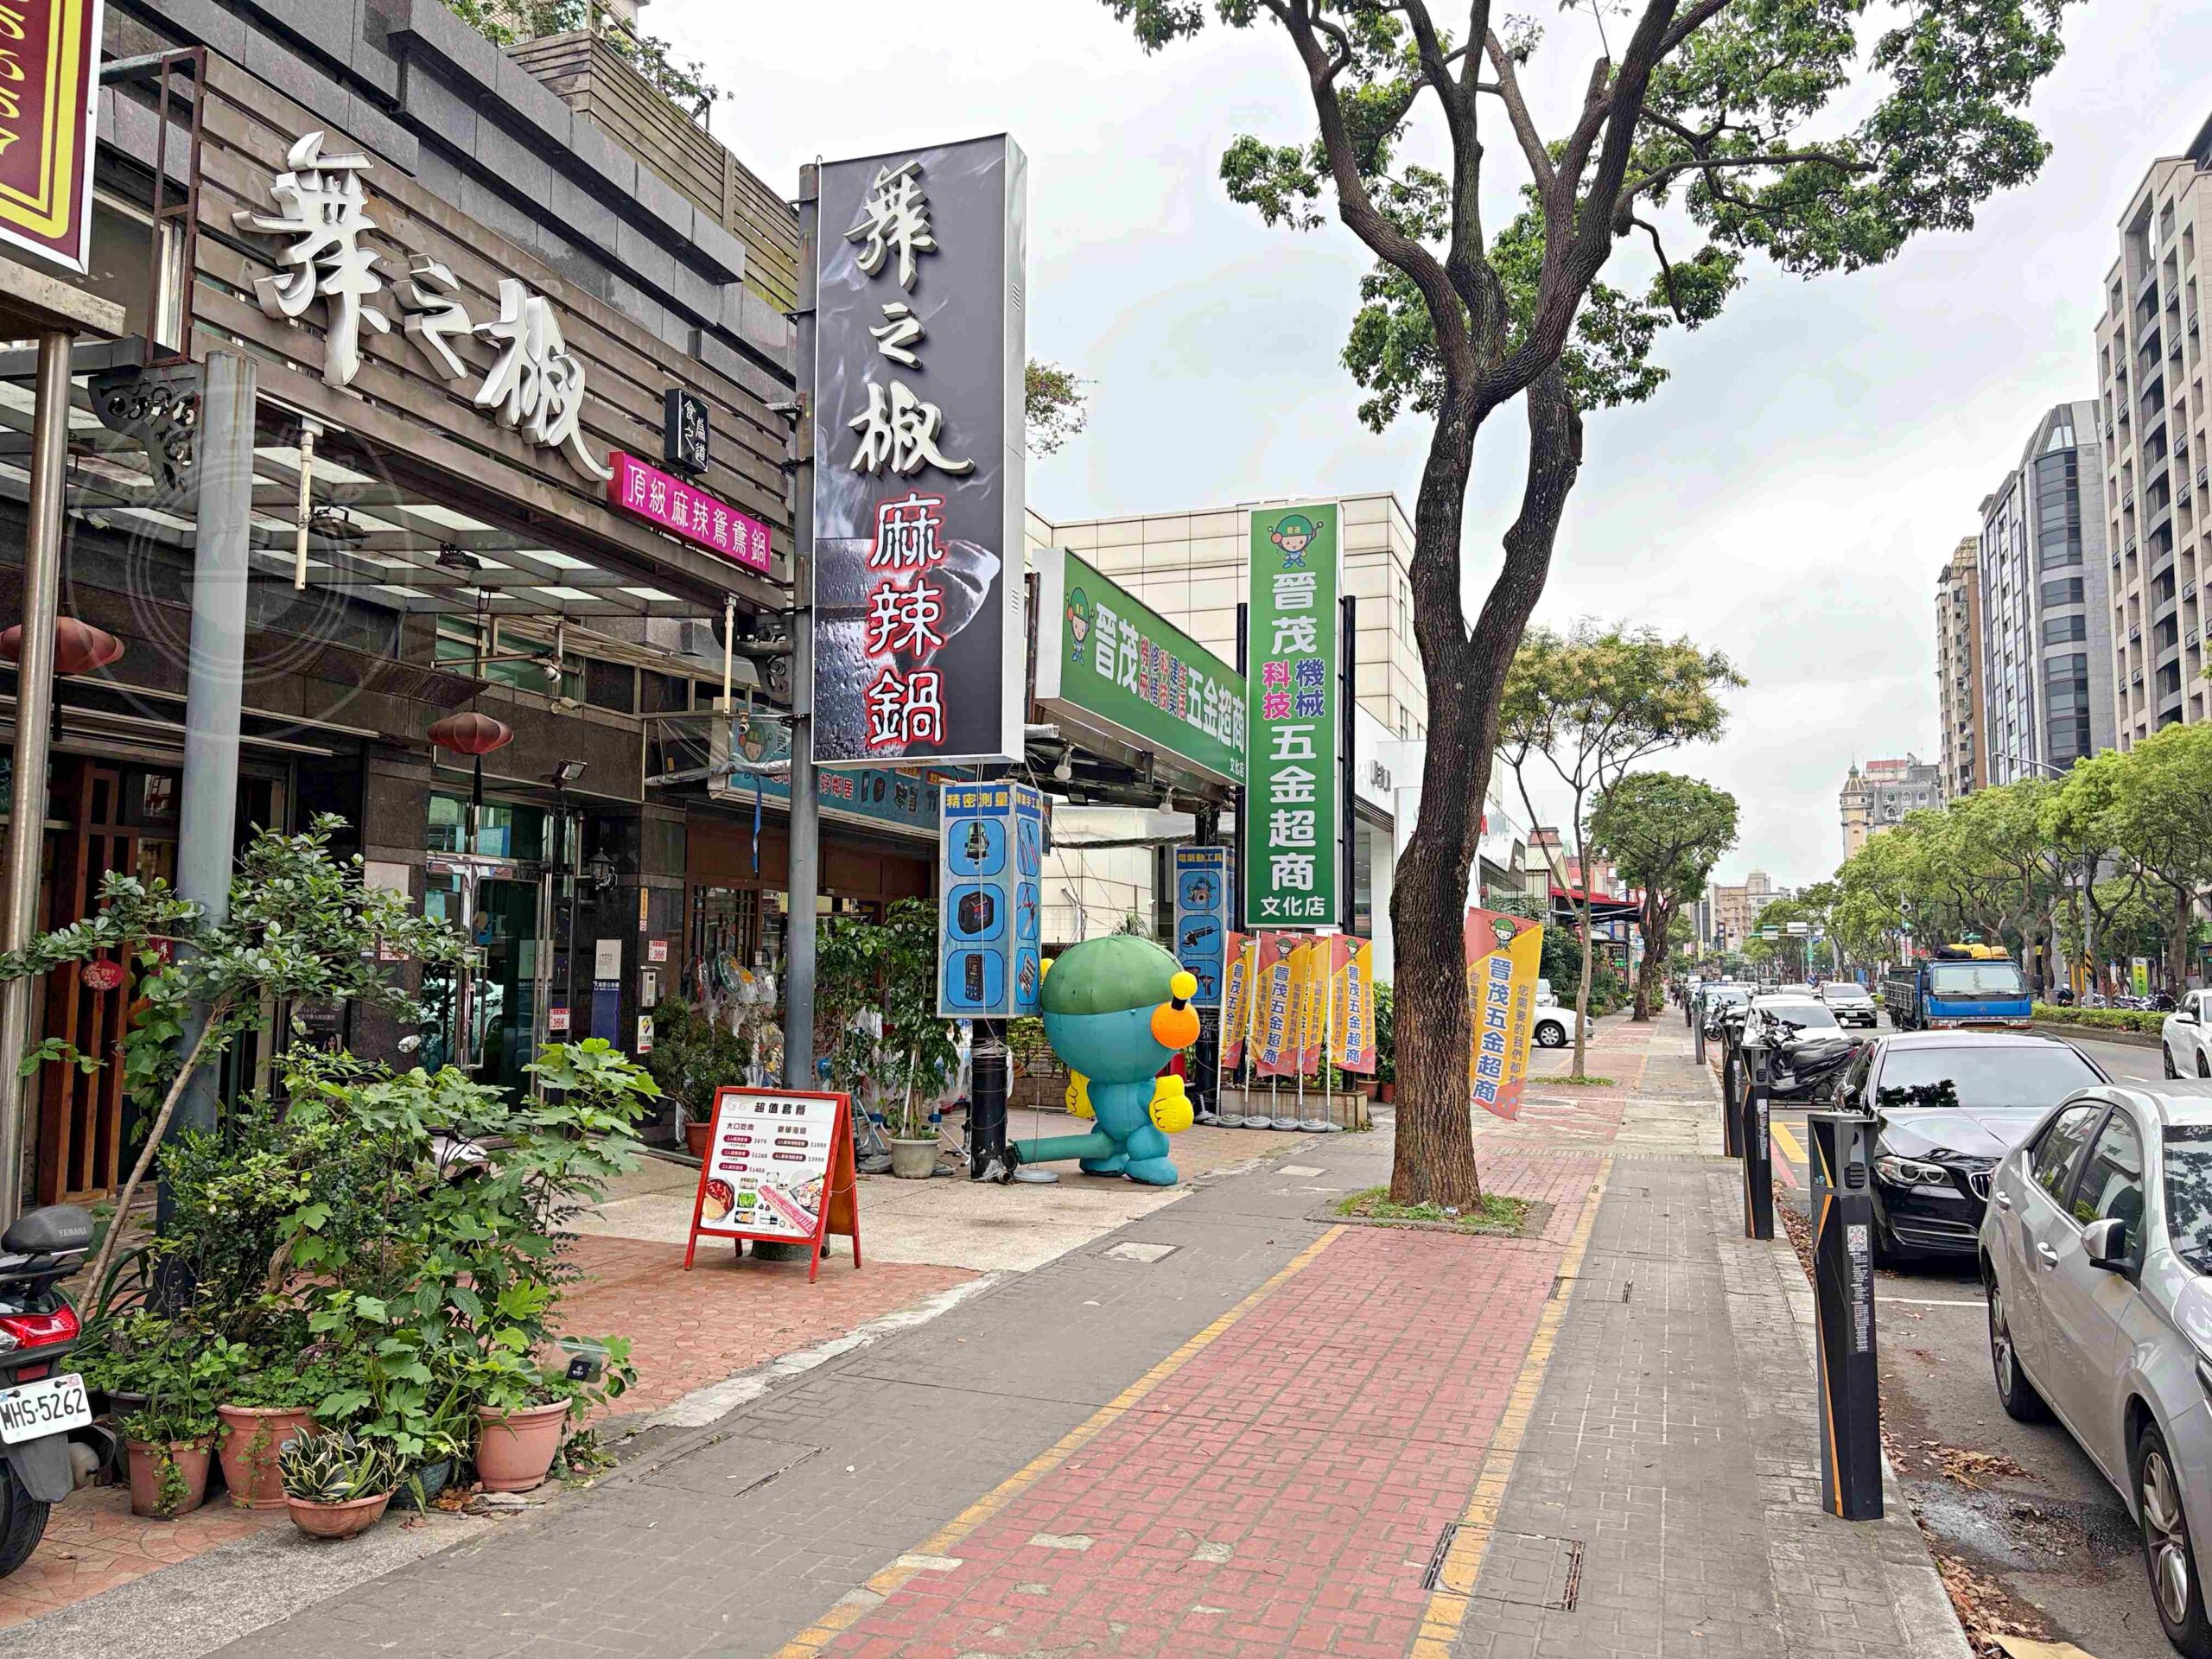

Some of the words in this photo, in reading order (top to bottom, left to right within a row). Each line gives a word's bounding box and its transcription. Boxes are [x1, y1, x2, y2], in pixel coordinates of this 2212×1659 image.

[232, 130, 614, 482] 舞之椒
[842, 158, 976, 478] 舞之椒
[626, 463, 767, 567] 頂級麻辣鴛鴦鍋
[868, 491, 945, 746] 麻辣鍋
[1186, 666, 1246, 755] 五金超商
[1262, 659, 1292, 720] 科技
[1295, 658, 1325, 719] 機械
[946, 791, 1010, 809] 精密測量
[1230, 757, 1245, 779] 文化店
[1268, 723, 1317, 892] 五金超商
[1260, 895, 1325, 918] 文化店
[1262, 964, 1292, 1065] 晉茂五金超商
[1345, 964, 1363, 1065] 晉茂五金超商
[1472, 957, 1512, 1104] 晉茂五金超商
[1509, 983, 1530, 1088] 您需要的我們都有
[753, 1103, 807, 1116] 超值套餐
[58, 1227, 87, 1237] YAMAHA
[0, 1388, 86, 1431] MHS-5262
